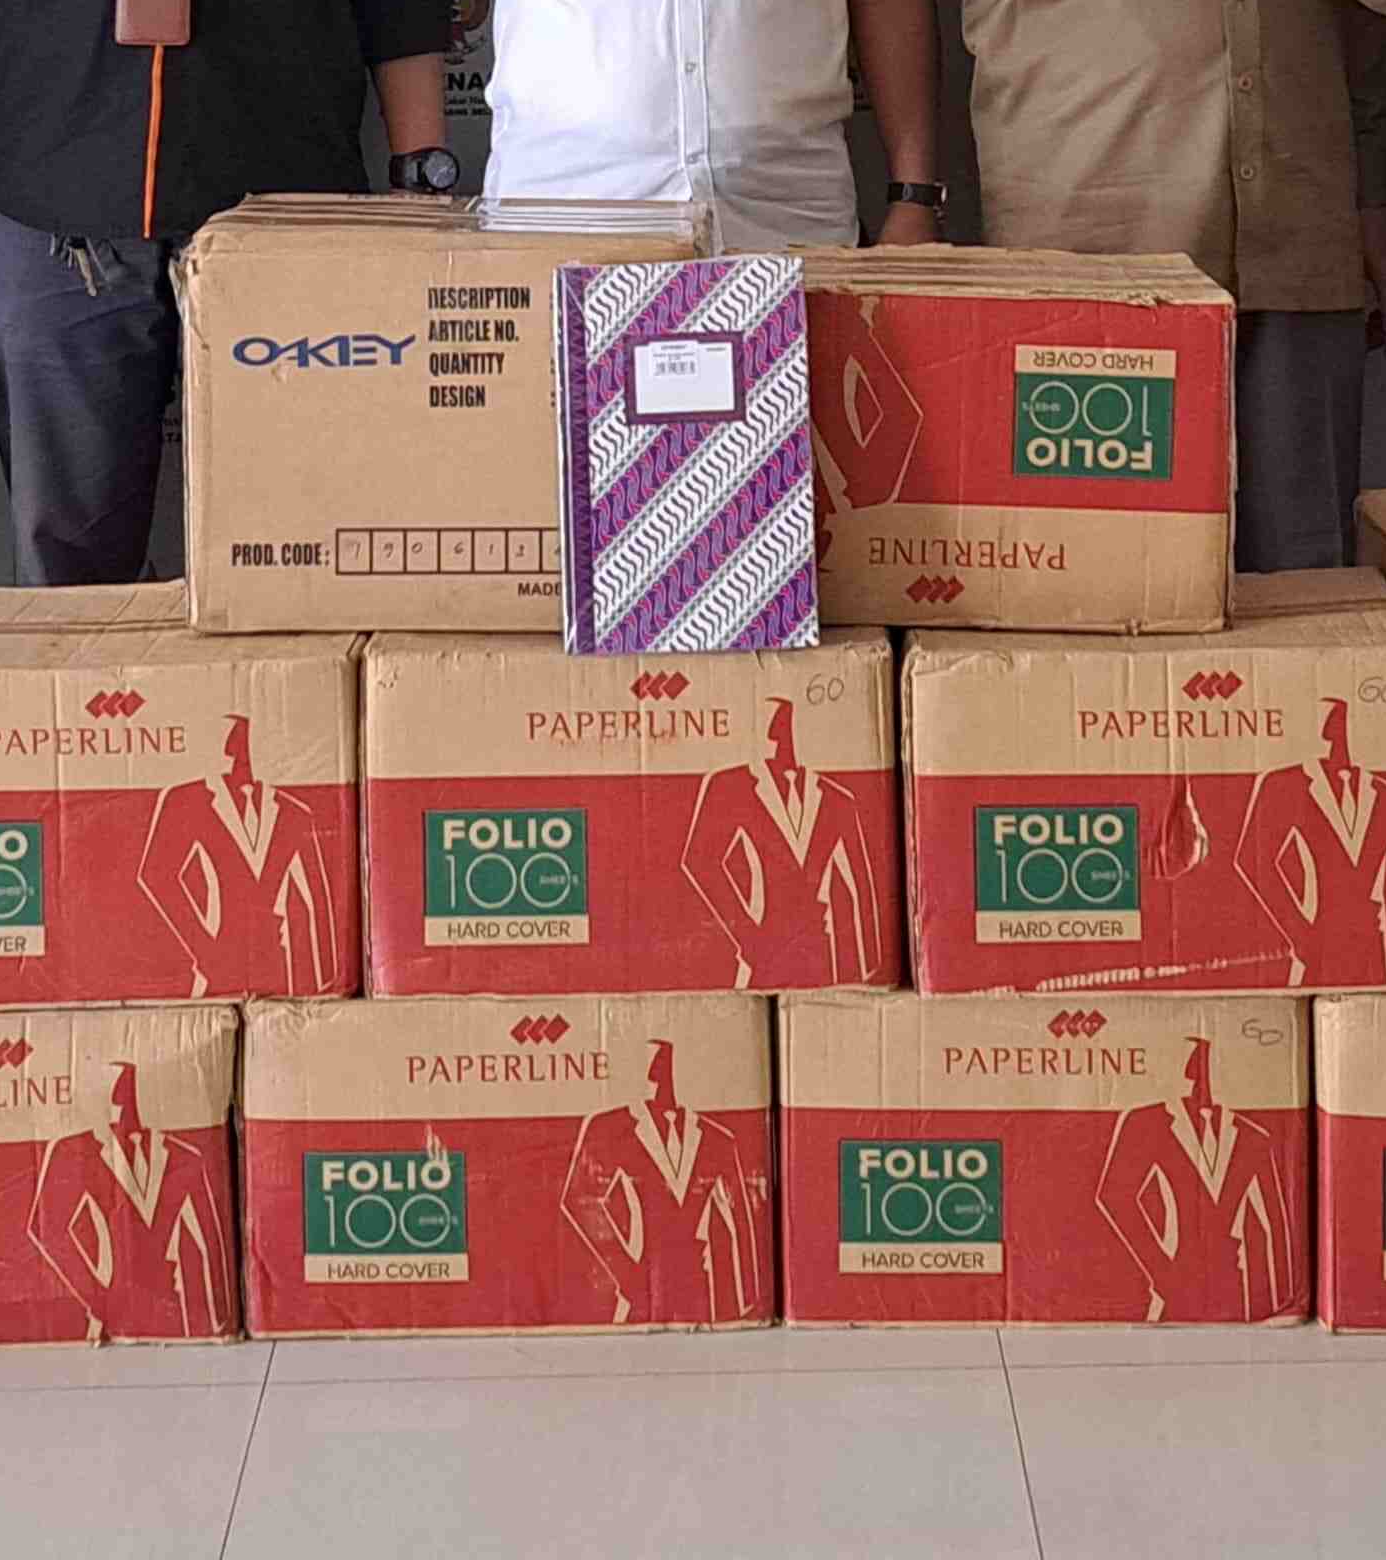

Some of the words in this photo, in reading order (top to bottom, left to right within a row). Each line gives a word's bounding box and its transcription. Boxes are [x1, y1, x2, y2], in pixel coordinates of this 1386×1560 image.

[428, 287, 531, 309] DESCRIPTION
[428, 319, 491, 342] ARTICLE
[494, 320, 519, 342] NO.
[429, 352, 504, 378] QUANTITY
[1033, 350, 1097, 369] COVER
[1102, 352, 1154, 371] HARD
[429, 385, 486, 409] DESIGN
[1028, 380, 1153, 437] 100
[1025, 436, 1153, 471] FOLIO
[231, 543, 277, 567] PROD.
[868, 536, 1067, 570] PAPERLINE
[805, 672, 846, 708] 60
[526, 709, 731, 740] PAPERLINE
[1077, 709, 1284, 739] PAPERLINE
[442, 818, 572, 850] FOLIO
[993, 814, 1124, 845] FOLIO
[444, 852, 571, 910] 100
[995, 847, 1123, 905] 100
[447, 921, 501, 939] HARD
[506, 920, 571, 938] COVER
[999, 920, 1052, 938] HARD
[1057, 920, 1124, 937] COVER
[1242, 1020, 1283, 1046] 60
[405, 1052, 610, 1084] PAPERLINE
[943, 1047, 1148, 1075] PAPERLINE
[322, 1159, 451, 1191] FOLIO
[859, 1148, 988, 1180] FOLIO
[323, 1193, 451, 1249] 100
[861, 1182, 988, 1237] 100
[328, 1262, 381, 1280] HARD
[385, 1261, 450, 1279] COVER
[862, 1252, 914, 1269] HARD
[920, 1251, 984, 1269] COVER
